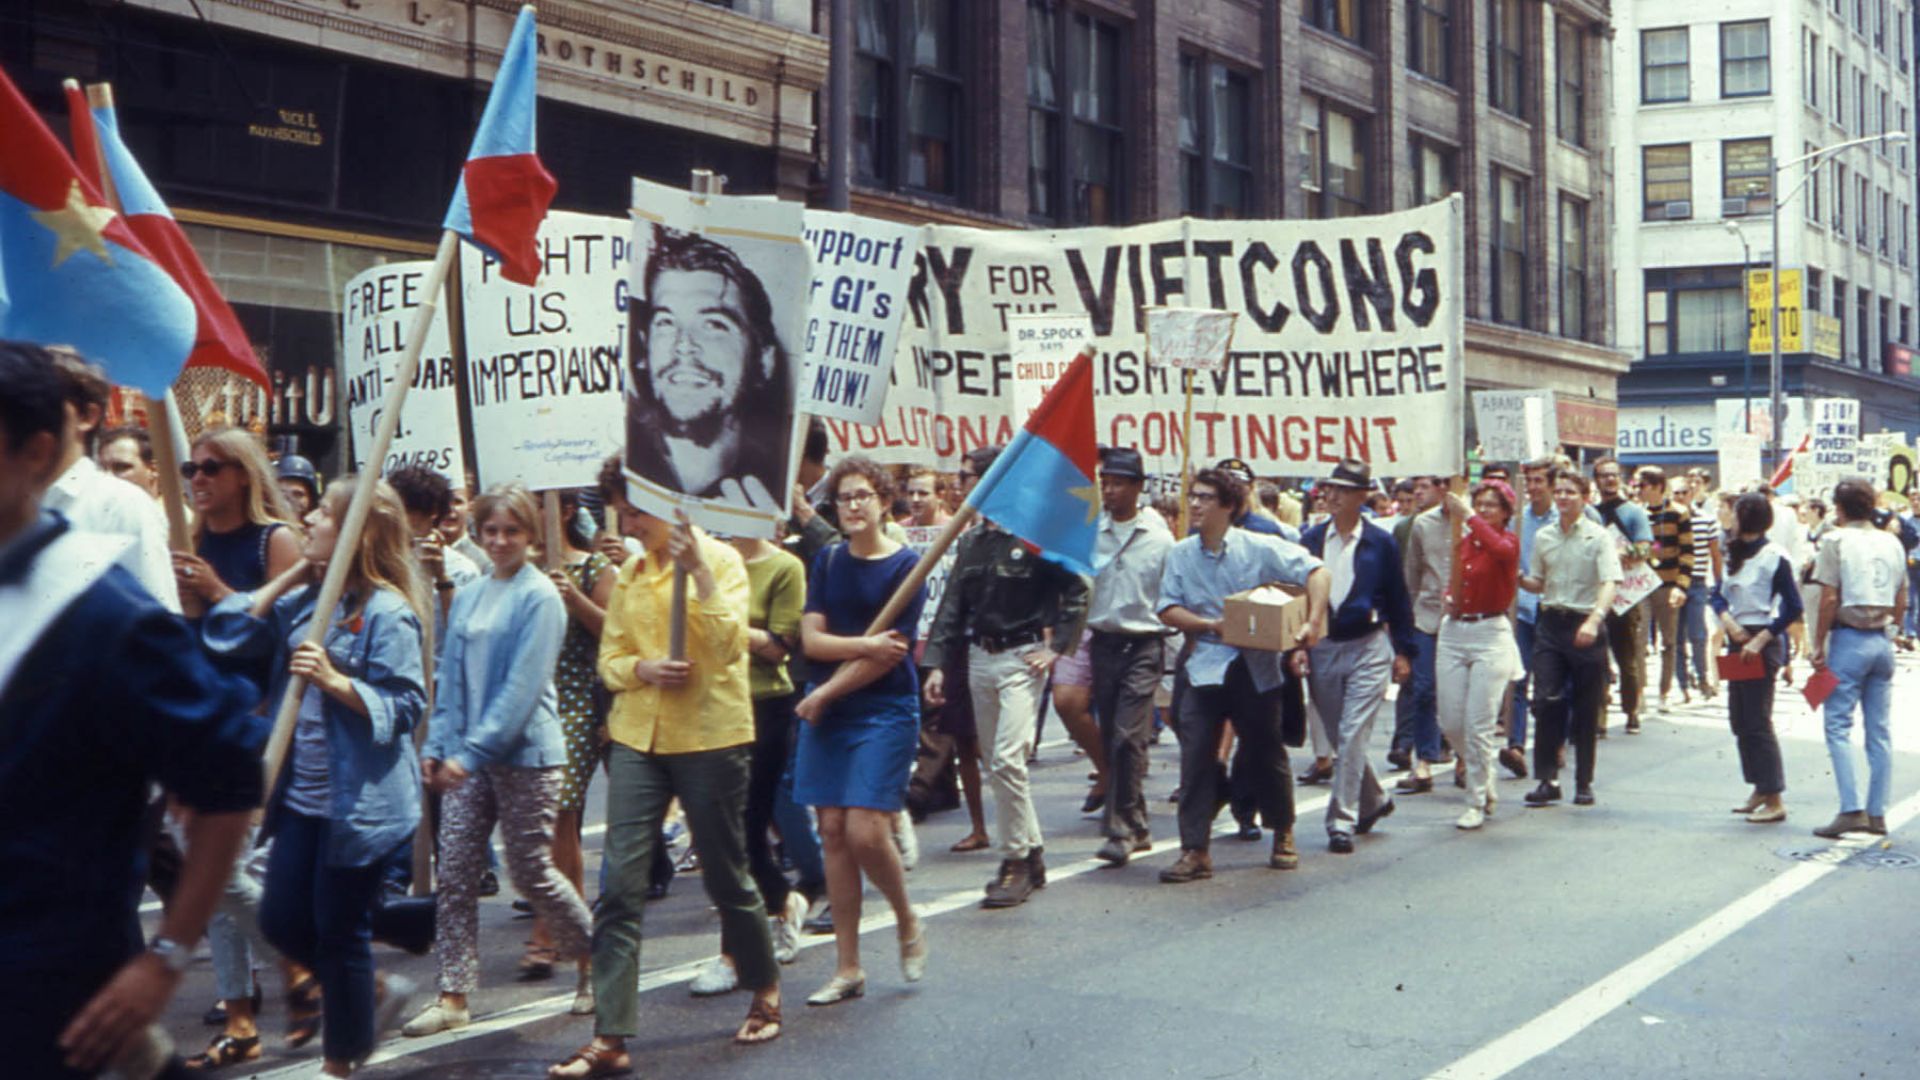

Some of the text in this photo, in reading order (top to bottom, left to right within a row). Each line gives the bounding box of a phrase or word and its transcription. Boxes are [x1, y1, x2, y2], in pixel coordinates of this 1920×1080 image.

[536, 32, 759, 106] ROTHSCHILD
[482, 234, 605, 285] FHT
[804, 226, 905, 271] pport
[350, 271, 424, 326] FREE
[831, 274, 893, 320] GI's
[987, 264, 1056, 296] FOR
[1064, 230, 1441, 337] VIETCONG
[505, 291, 572, 338] U.S.
[1042, 327, 1085, 340] SPOCK
[1747, 306, 1799, 339] PHTO
[363, 320, 406, 362] ALL
[824, 319, 885, 367] THEM
[812, 364, 870, 410] NOW!
[1017, 361, 1056, 381] CHILD
[1480, 394, 1542, 412] ABAND
[1110, 410, 1398, 464] CONTINGENT
[1618, 415, 1713, 449] andies
